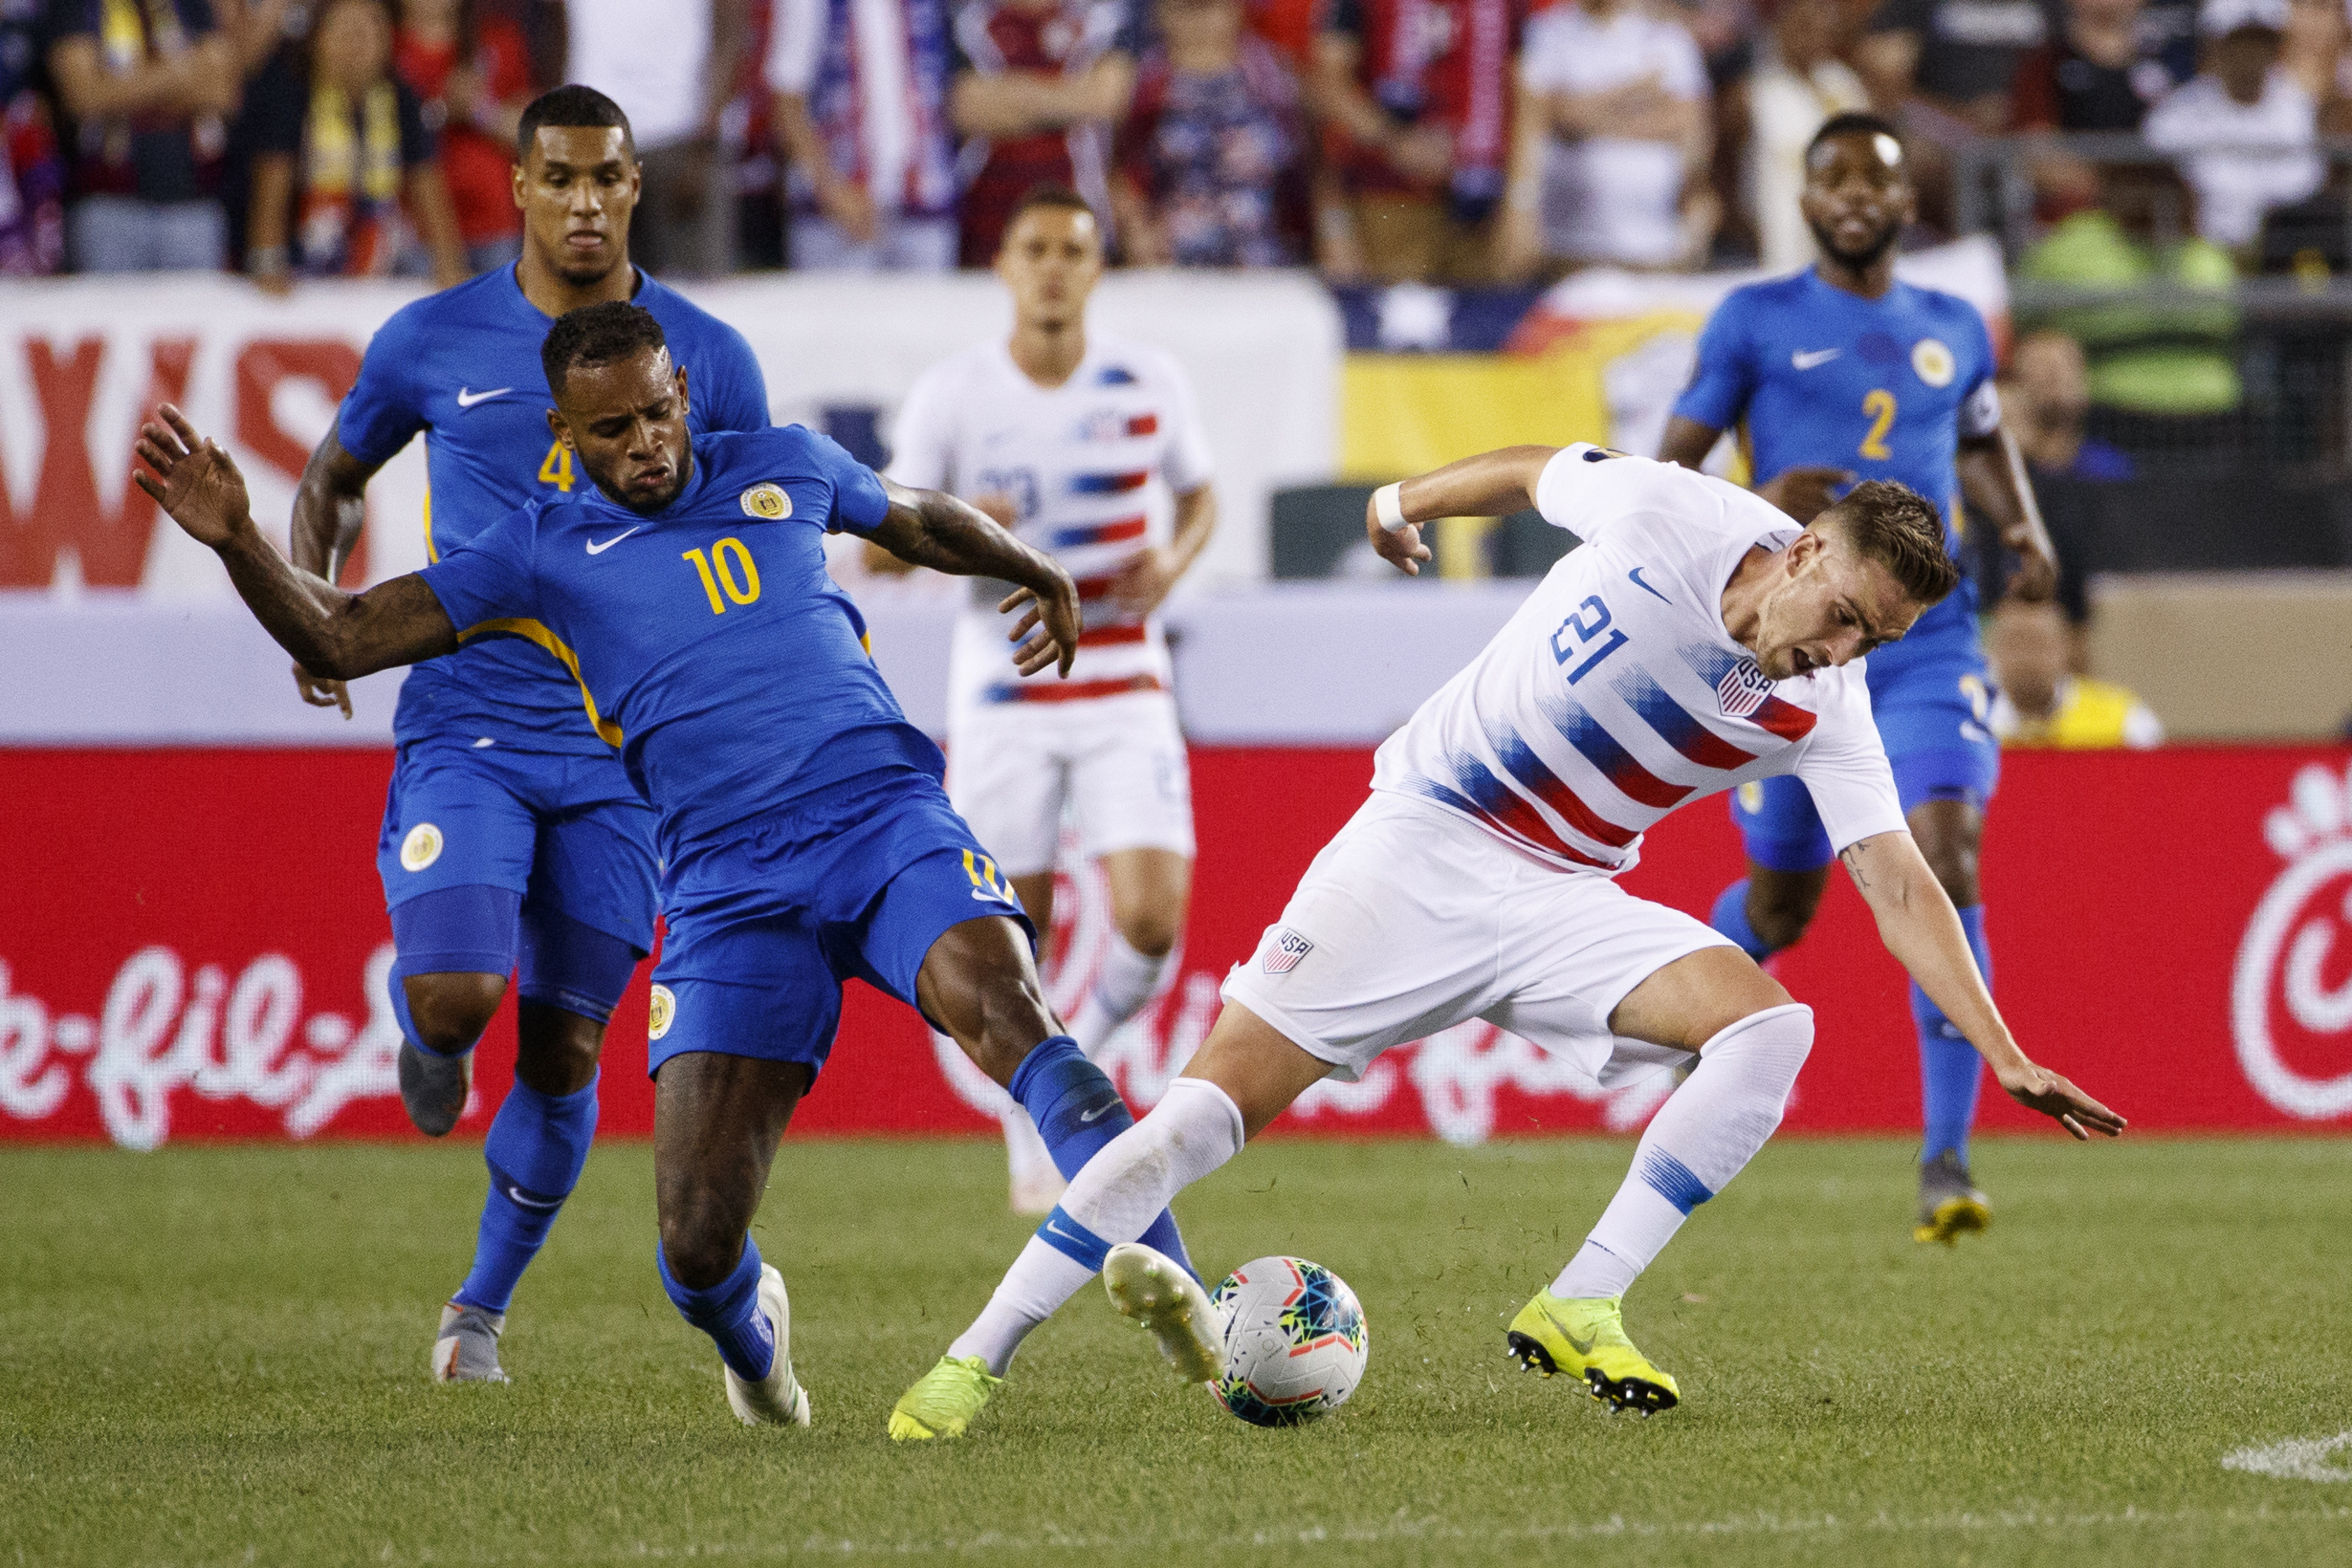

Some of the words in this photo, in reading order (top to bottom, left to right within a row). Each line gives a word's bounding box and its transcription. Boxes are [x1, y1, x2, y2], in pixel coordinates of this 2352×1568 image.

[1858, 389, 1897, 460] 2
[538, 441, 577, 492] 4
[681, 537, 761, 615] 10
[1550, 594, 1630, 687] 21
[1737, 658, 1774, 693] USA
[1280, 931, 1309, 954] USA
